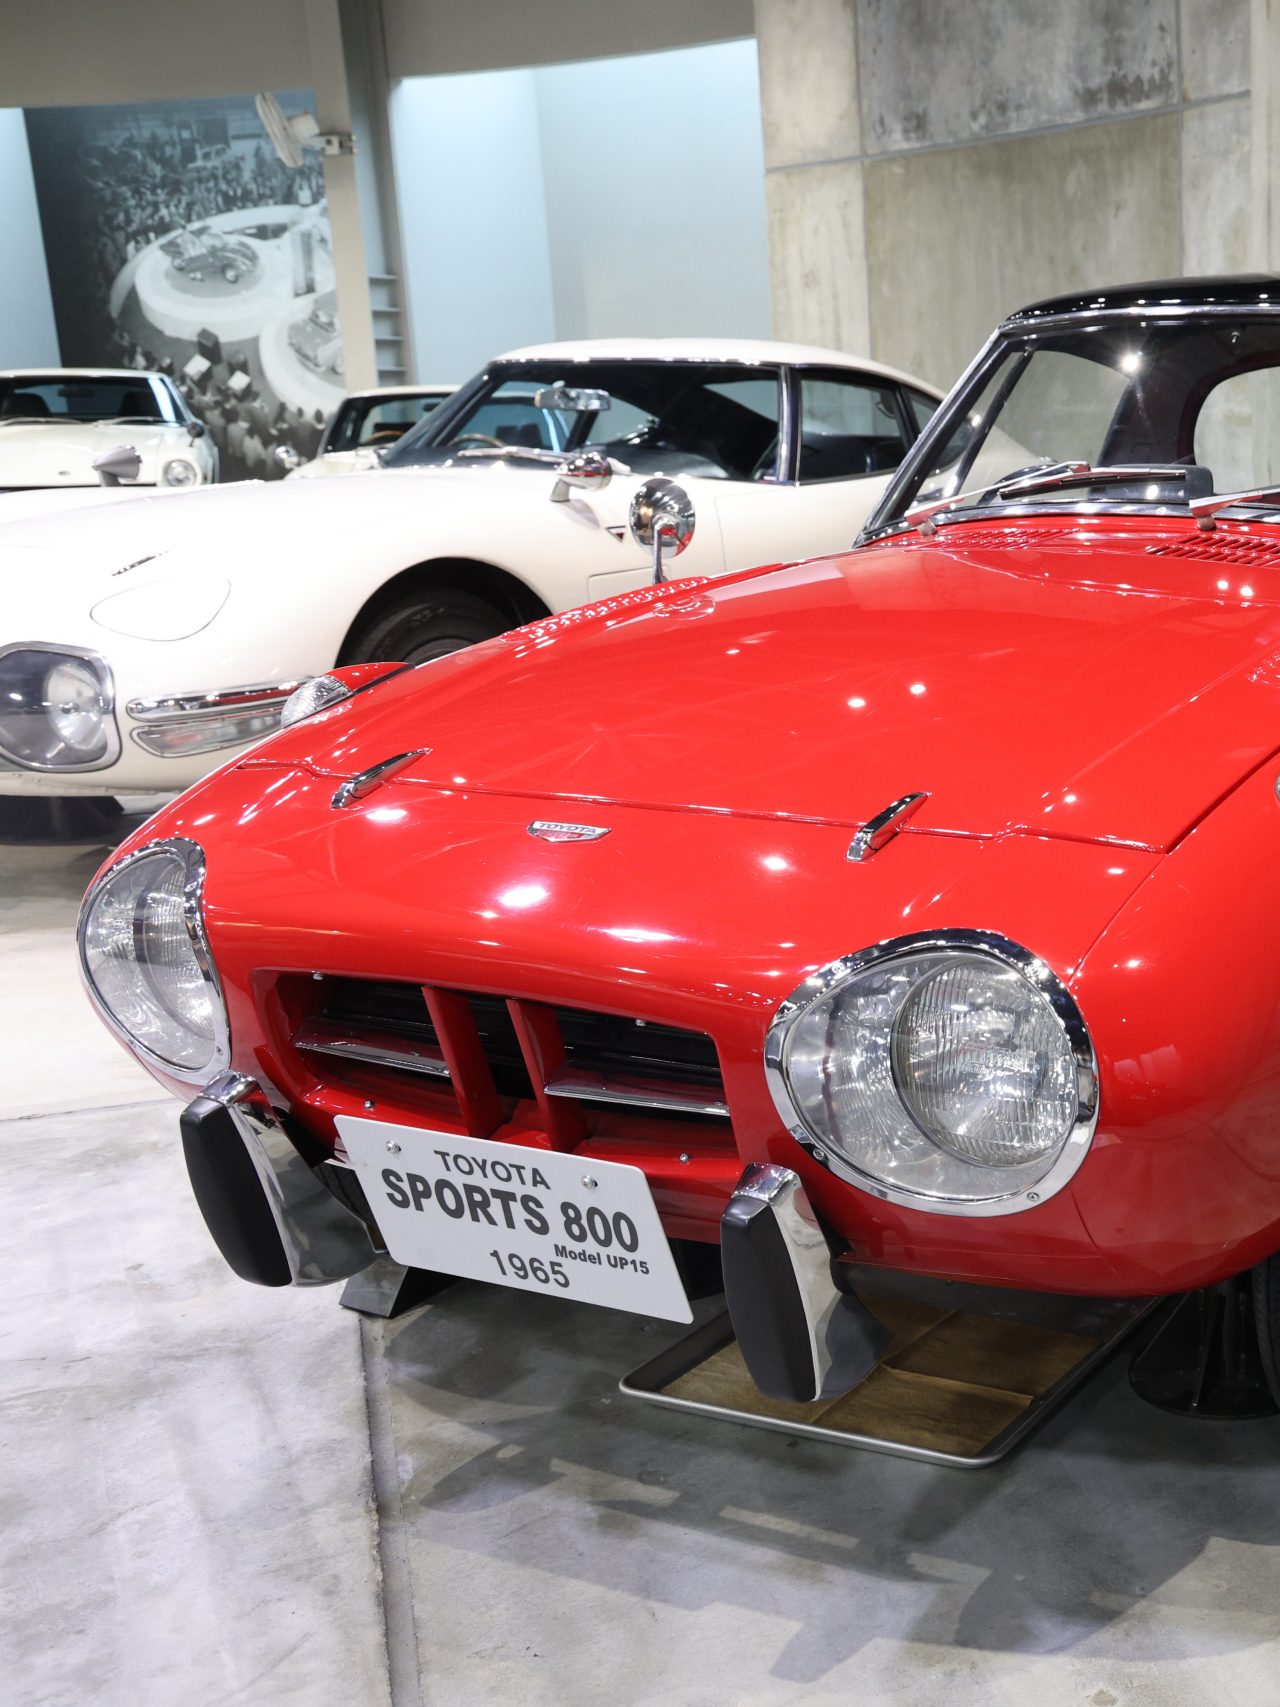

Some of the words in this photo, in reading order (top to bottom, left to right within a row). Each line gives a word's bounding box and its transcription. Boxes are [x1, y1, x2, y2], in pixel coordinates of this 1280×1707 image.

[539, 822, 597, 834] TOYOTA
[433, 1149, 552, 1190] TOYOTA
[381, 1167, 550, 1236] SPORTS
[560, 1200, 639, 1253] 800
[489, 1249, 570, 1288] 1965
[554, 1243, 602, 1266] Model
[606, 1253, 650, 1275] UP15
